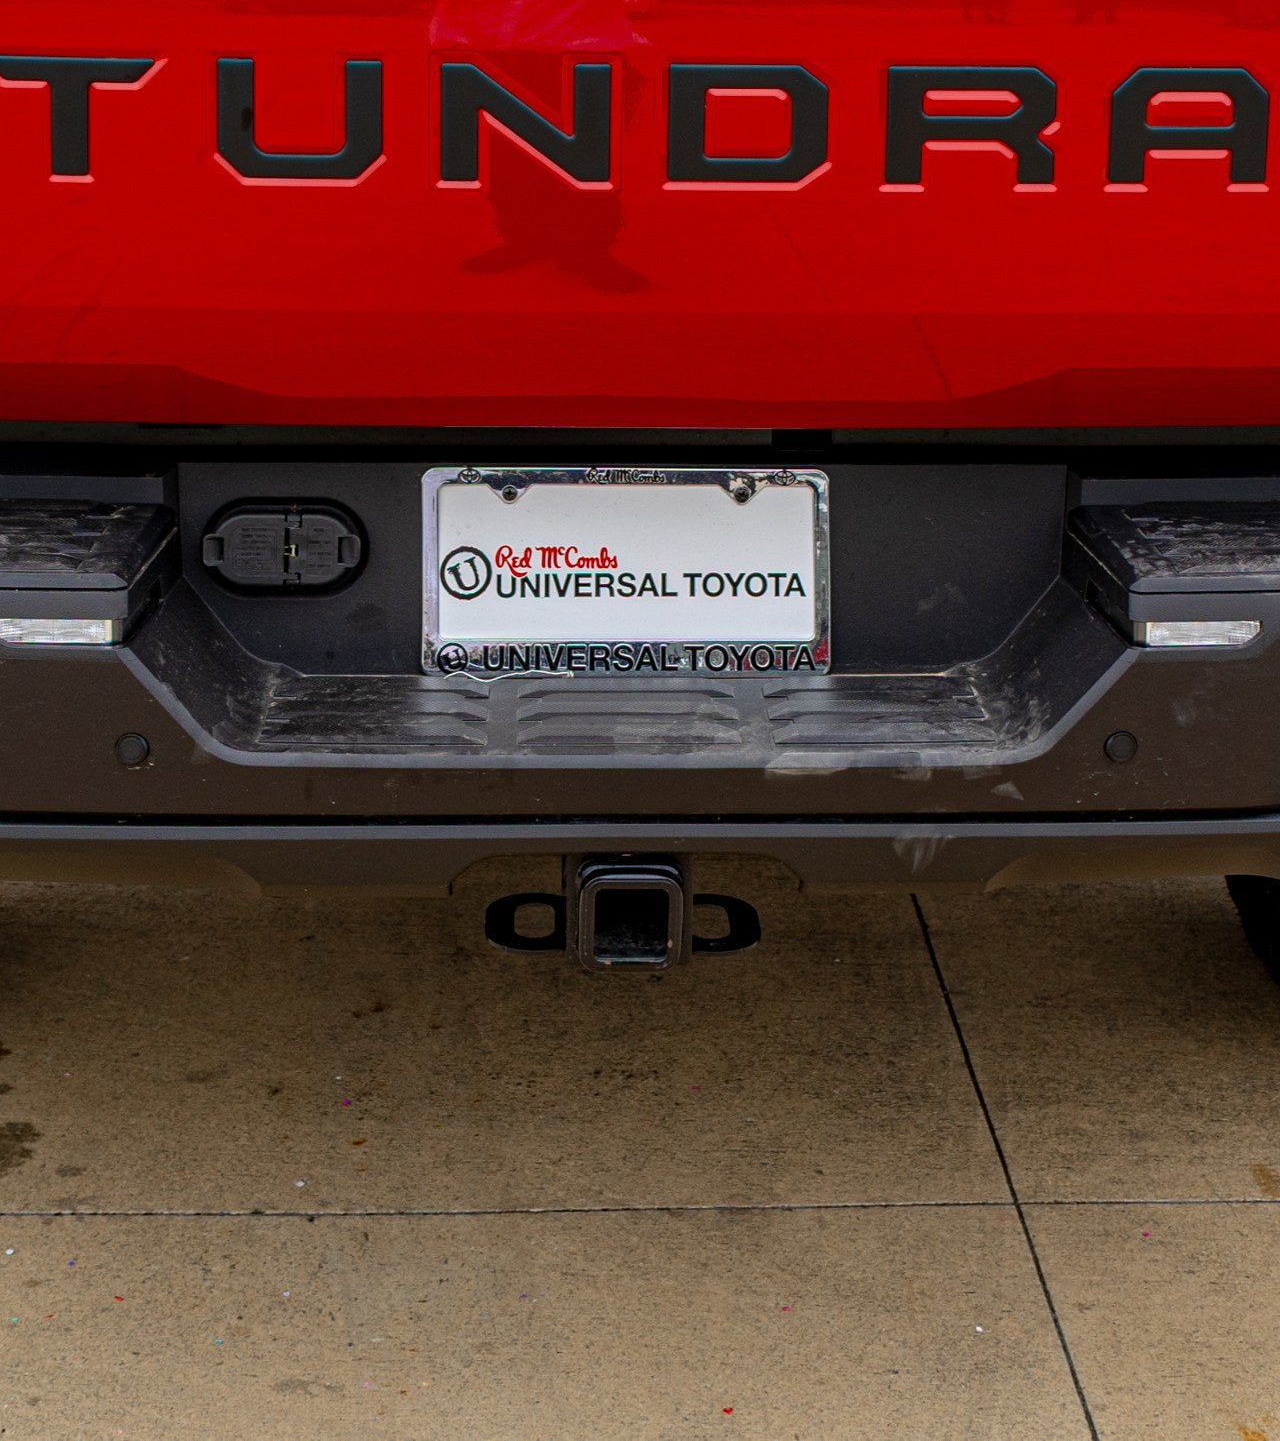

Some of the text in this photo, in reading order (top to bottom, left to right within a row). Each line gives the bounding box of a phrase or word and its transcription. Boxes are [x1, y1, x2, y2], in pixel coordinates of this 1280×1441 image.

[495, 545, 619, 578] Red McCombs
[496, 572, 807, 599] UNIVERSAL TOYOTA
[482, 643, 817, 672] UNIVERSAL TOYOTA
